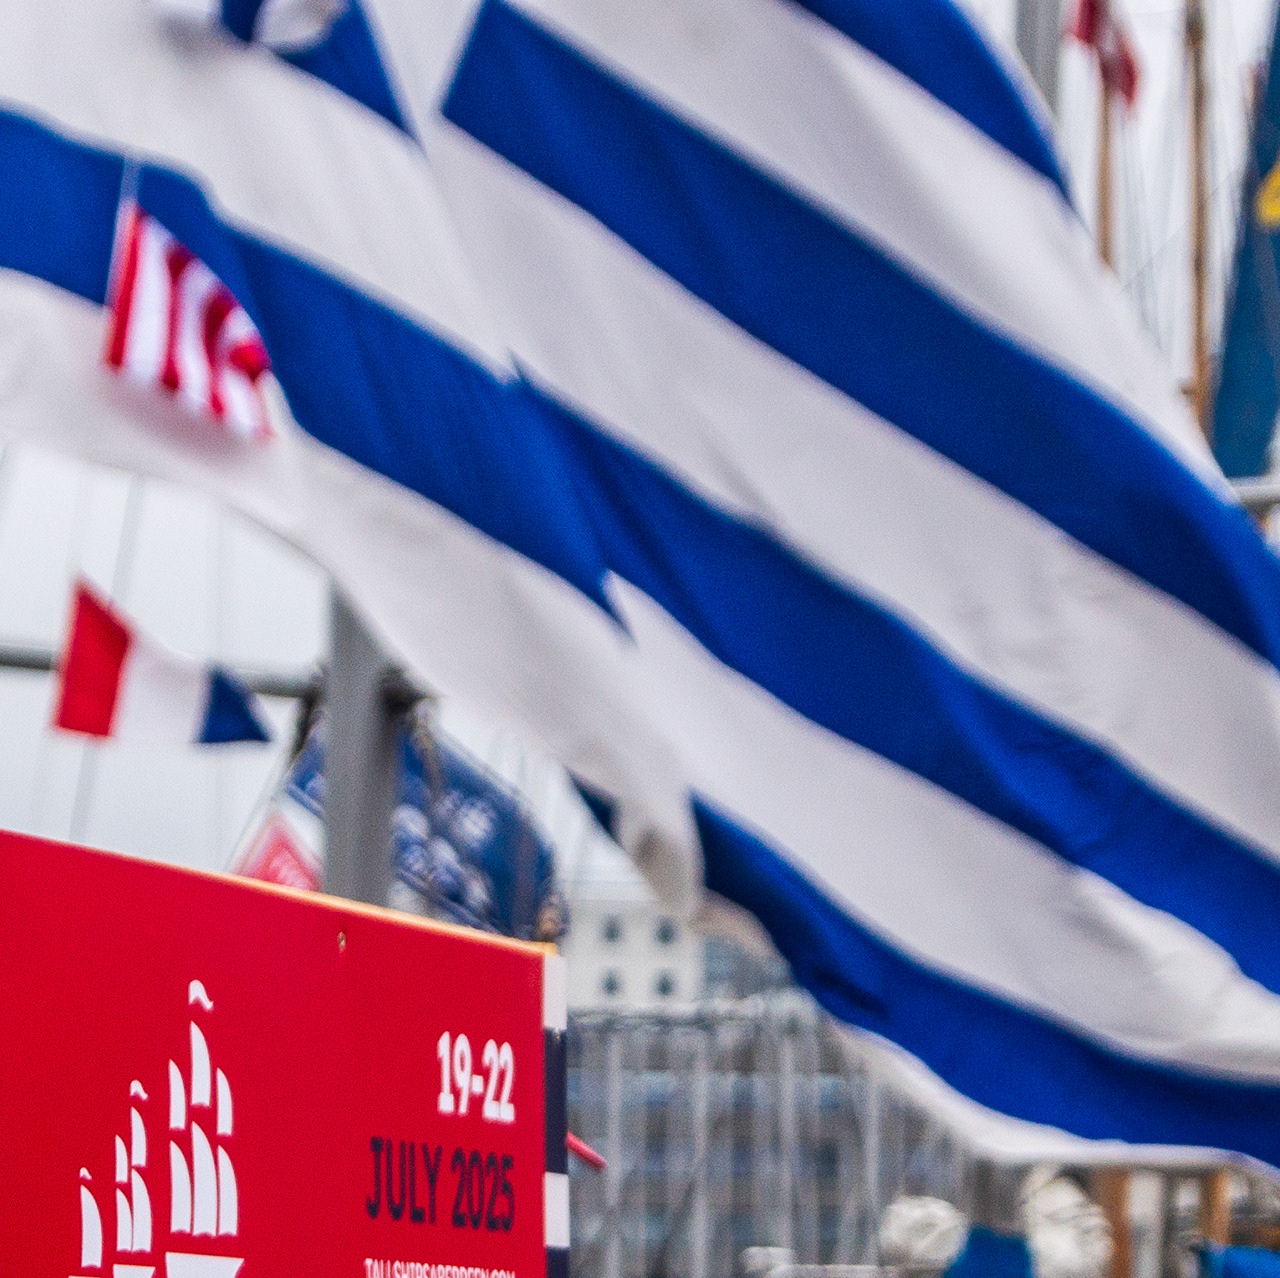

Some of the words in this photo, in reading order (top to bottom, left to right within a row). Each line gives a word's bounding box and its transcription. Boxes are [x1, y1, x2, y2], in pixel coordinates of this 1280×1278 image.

[436, 1030, 516, 1122] 19-22
[366, 1135, 443, 1225] JULY
[450, 1145, 516, 1232] 2025
